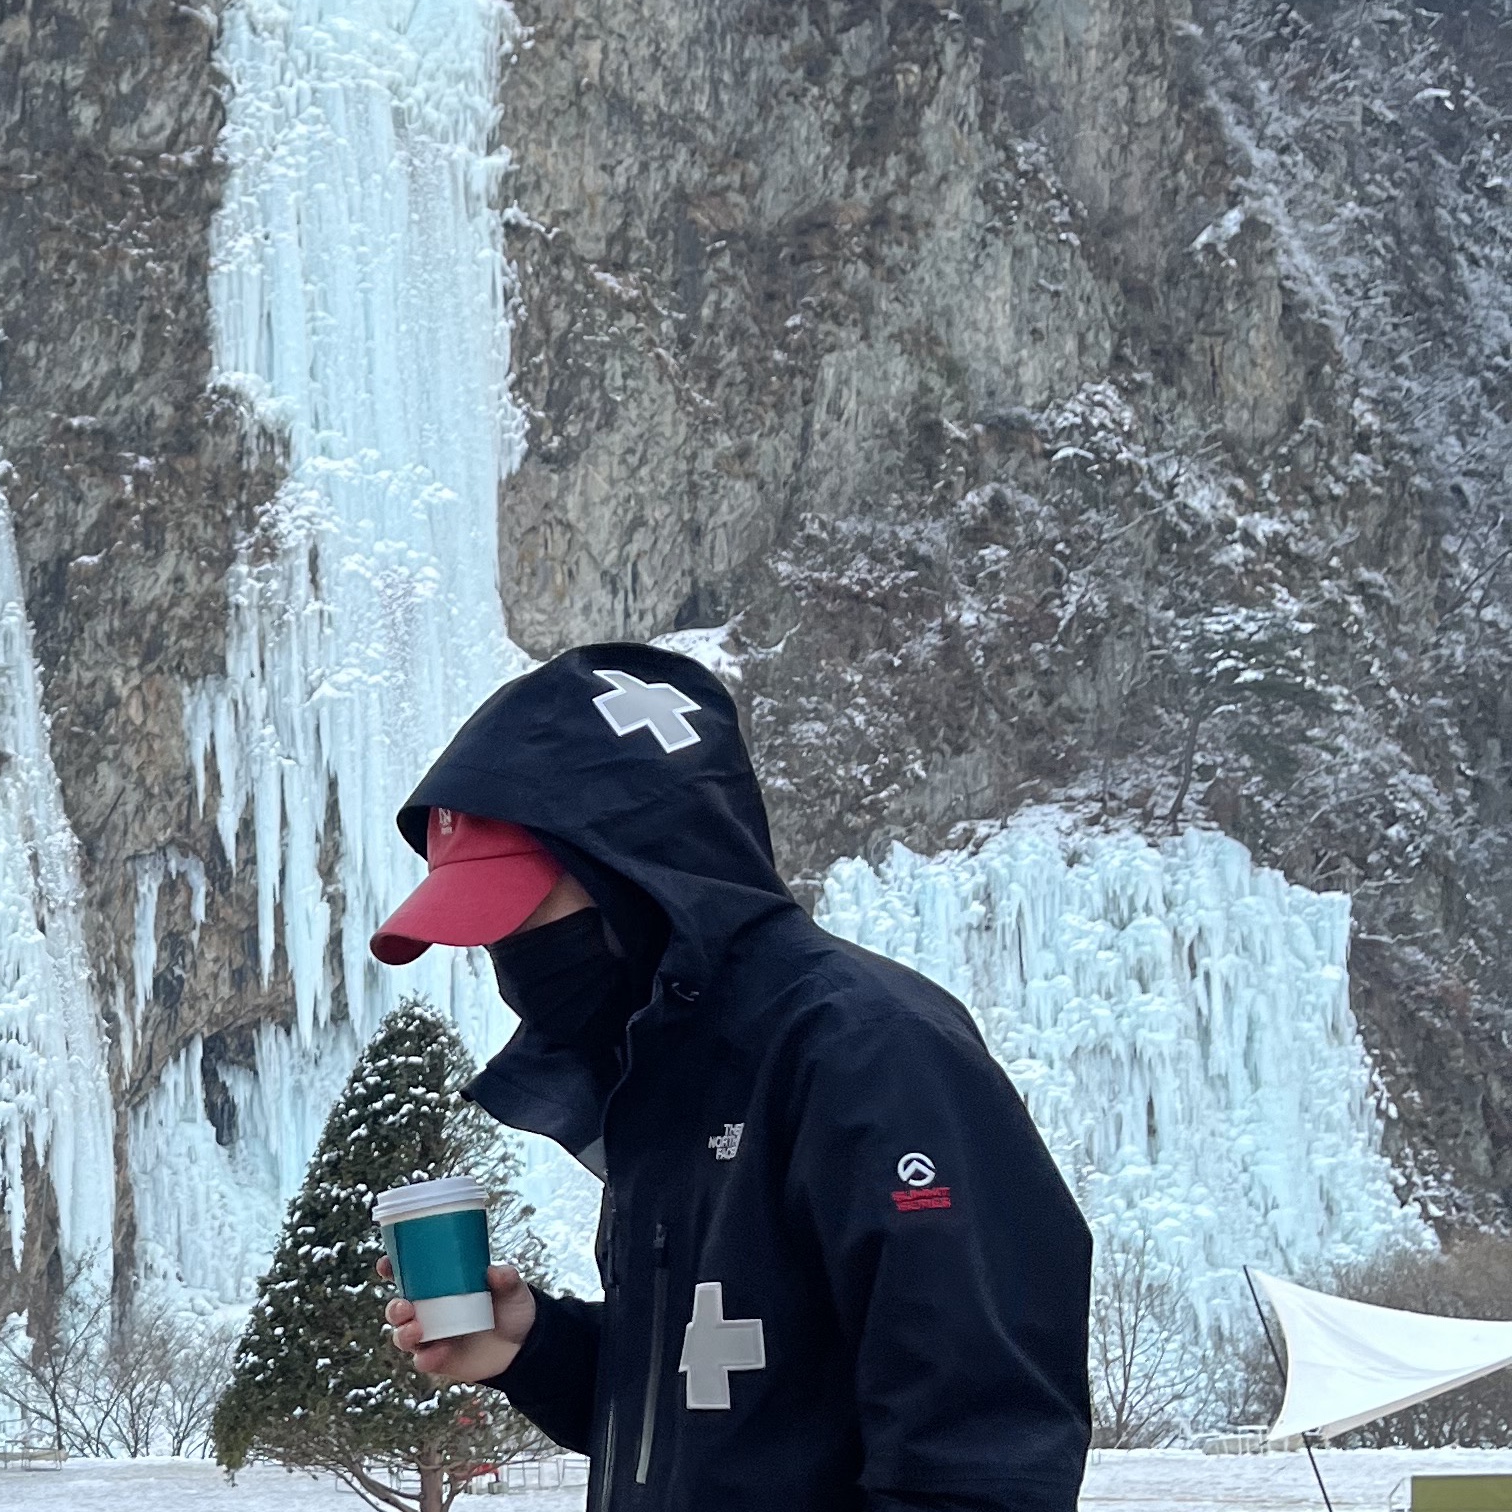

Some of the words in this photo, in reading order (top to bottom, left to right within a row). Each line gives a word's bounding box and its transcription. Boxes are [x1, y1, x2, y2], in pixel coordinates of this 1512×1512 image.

[724, 1124, 742, 1136] THE
[708, 1136, 738, 1148] NORTH
[716, 1148, 735, 1160] FACE
